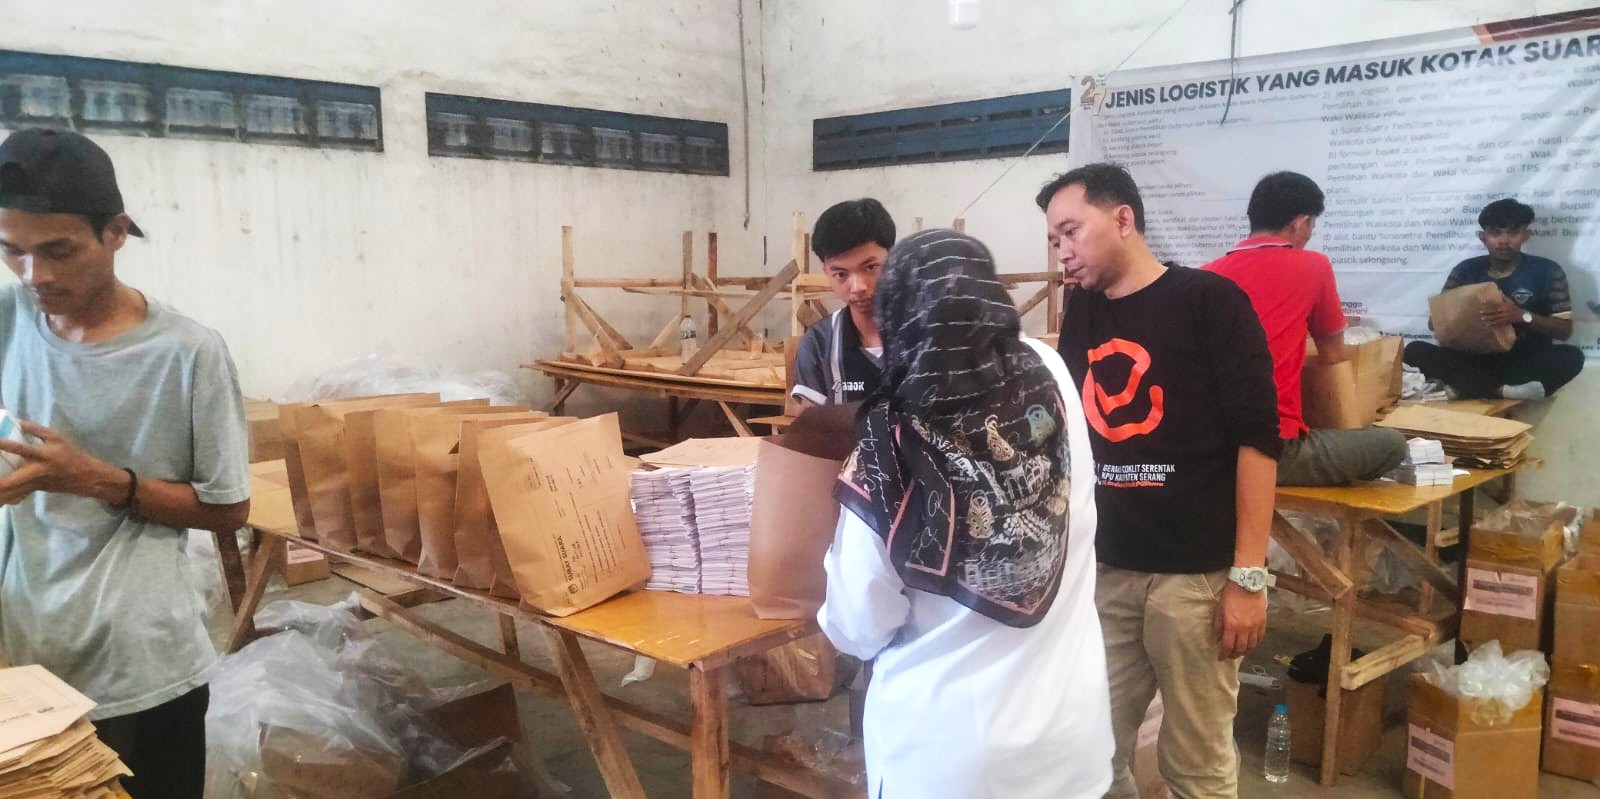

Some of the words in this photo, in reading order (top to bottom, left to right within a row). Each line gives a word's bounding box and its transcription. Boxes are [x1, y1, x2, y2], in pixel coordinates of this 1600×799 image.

[1105, 87, 1155, 108] JENIS
[1160, 77, 1251, 102] LOGISTIK
[1256, 69, 1320, 92] YANG
[1324, 57, 1415, 85] MASUK
[1421, 44, 1517, 74] KOTAK
[1523, 34, 1600, 63] SUAR
[1141, 464, 1176, 473] SERENTAK
[1139, 473, 1166, 482] SERANG
